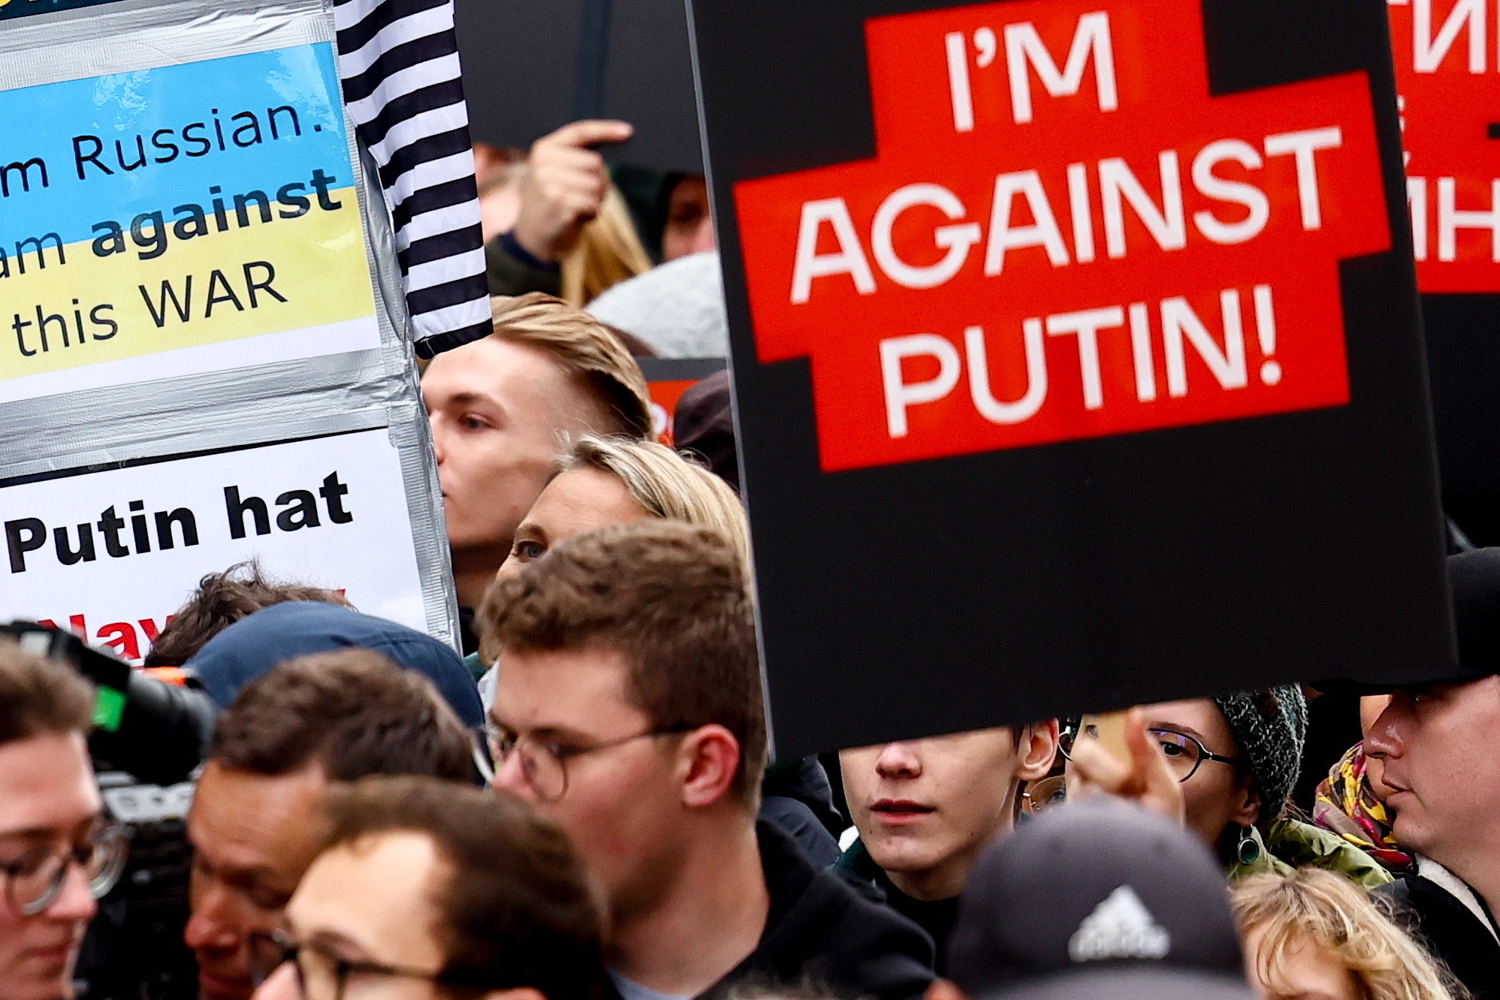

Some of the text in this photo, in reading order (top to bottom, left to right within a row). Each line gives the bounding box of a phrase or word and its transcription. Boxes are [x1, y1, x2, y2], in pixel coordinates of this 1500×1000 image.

[944, 10, 1118, 133] I'M
[71, 104, 323, 181] Russian.
[90, 168, 343, 260] against
[790, 126, 1342, 304] AGAINST
[11, 260, 288, 358] this WAR
[879, 284, 1283, 439] PUTIN!
[4, 470, 353, 574] Putin hat
